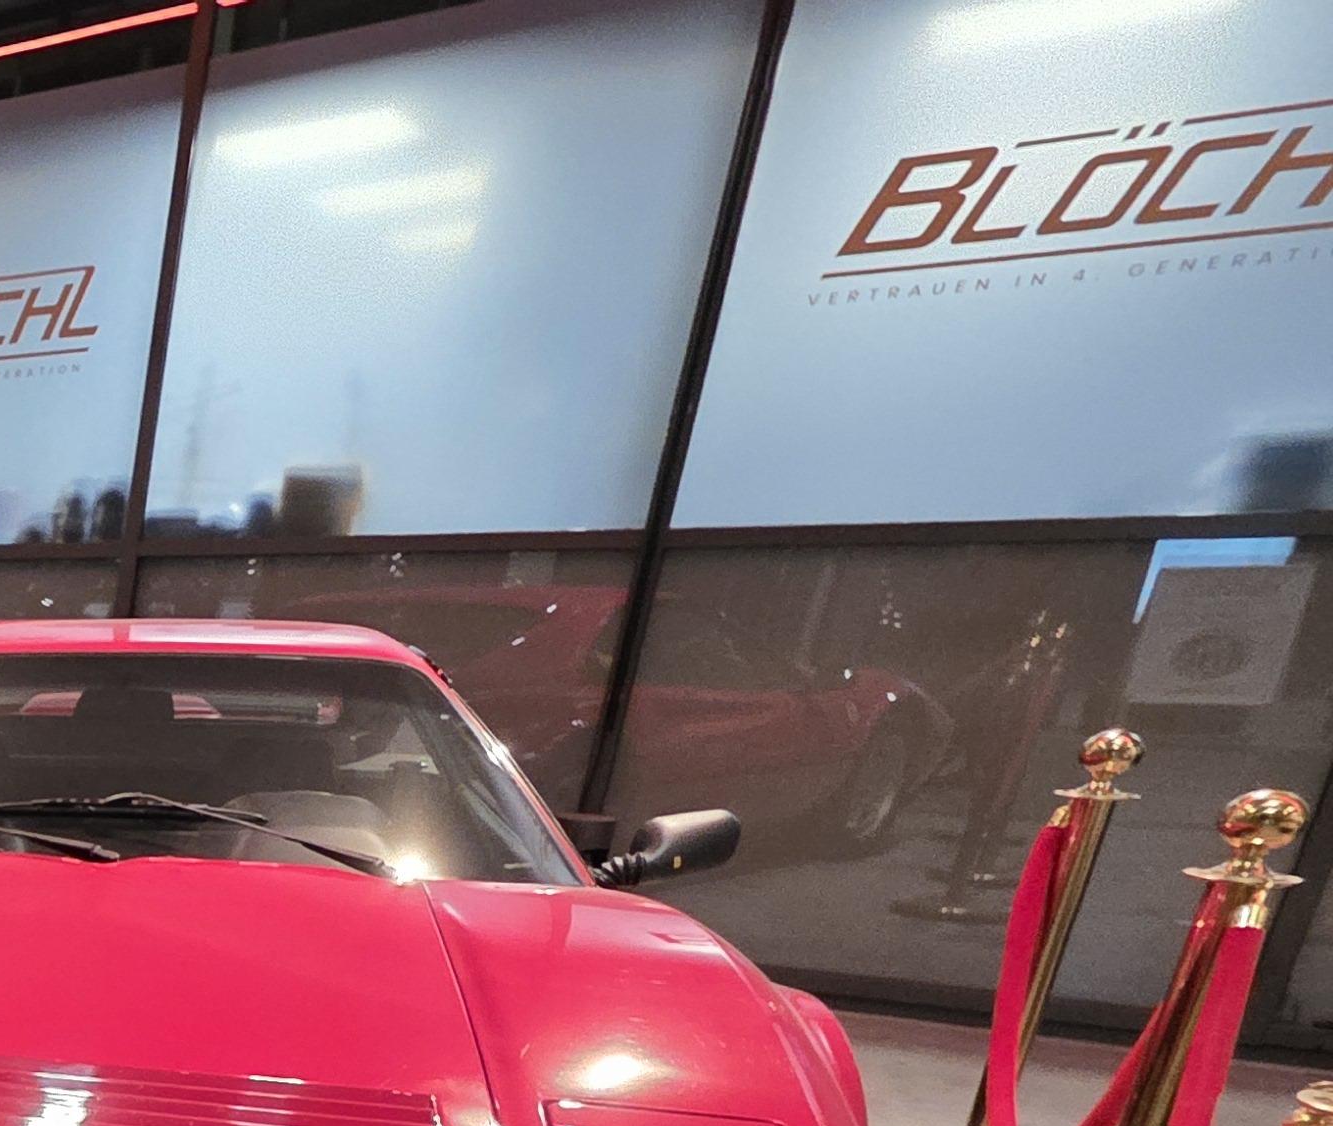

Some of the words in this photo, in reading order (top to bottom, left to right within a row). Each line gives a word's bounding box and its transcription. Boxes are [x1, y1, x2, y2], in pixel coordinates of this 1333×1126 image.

[807, 277, 992, 306] VERTRAUEN
[1015, 273, 1047, 289] IN
[1127, 246, 1333, 277] GENERATI
